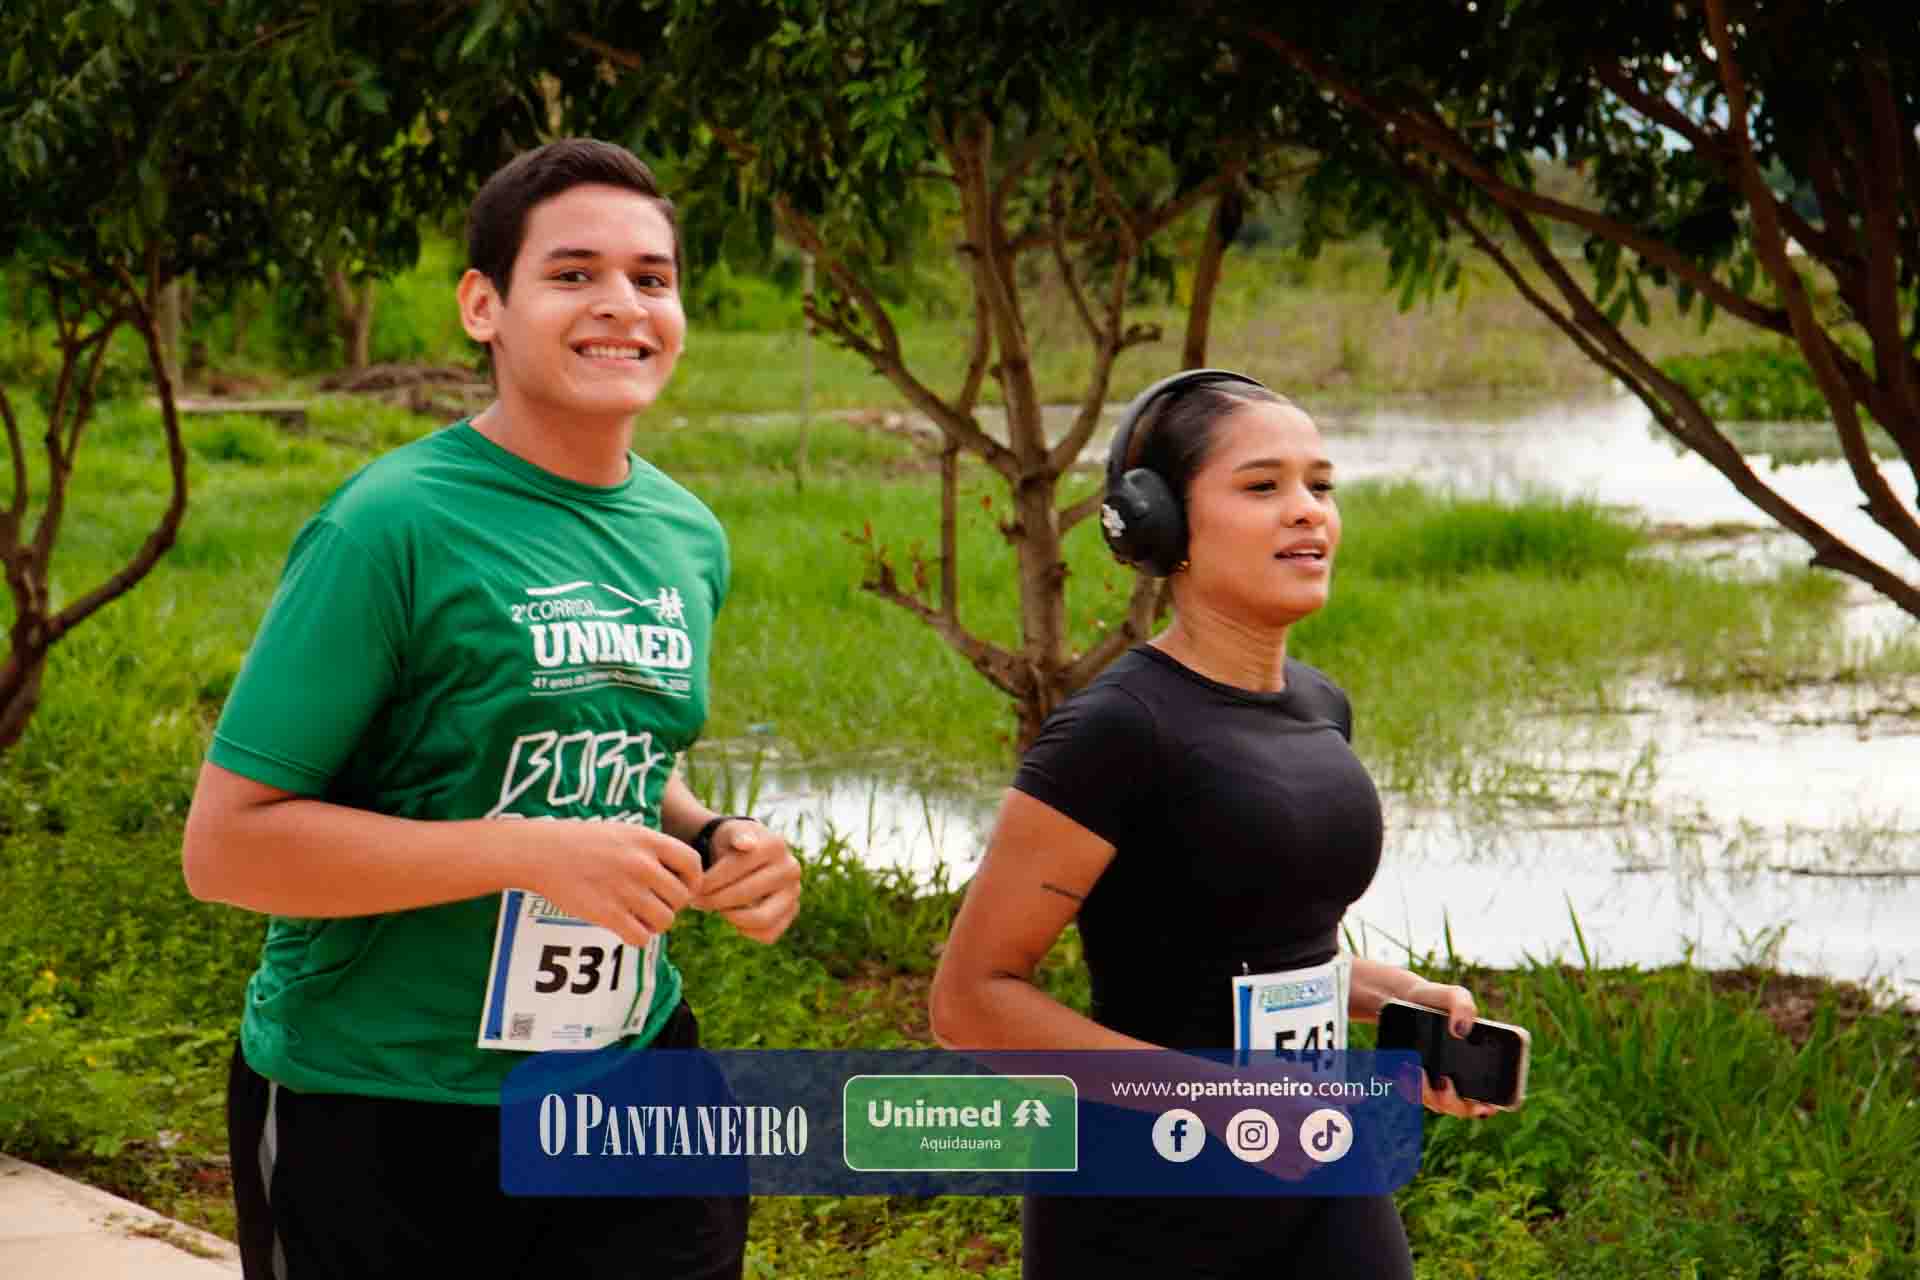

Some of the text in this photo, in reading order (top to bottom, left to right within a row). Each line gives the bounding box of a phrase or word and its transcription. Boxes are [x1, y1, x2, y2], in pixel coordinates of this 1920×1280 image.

[530, 620, 693, 670] UNIMED
[484, 729, 666, 819] BORA
[535, 943, 625, 995] 531
